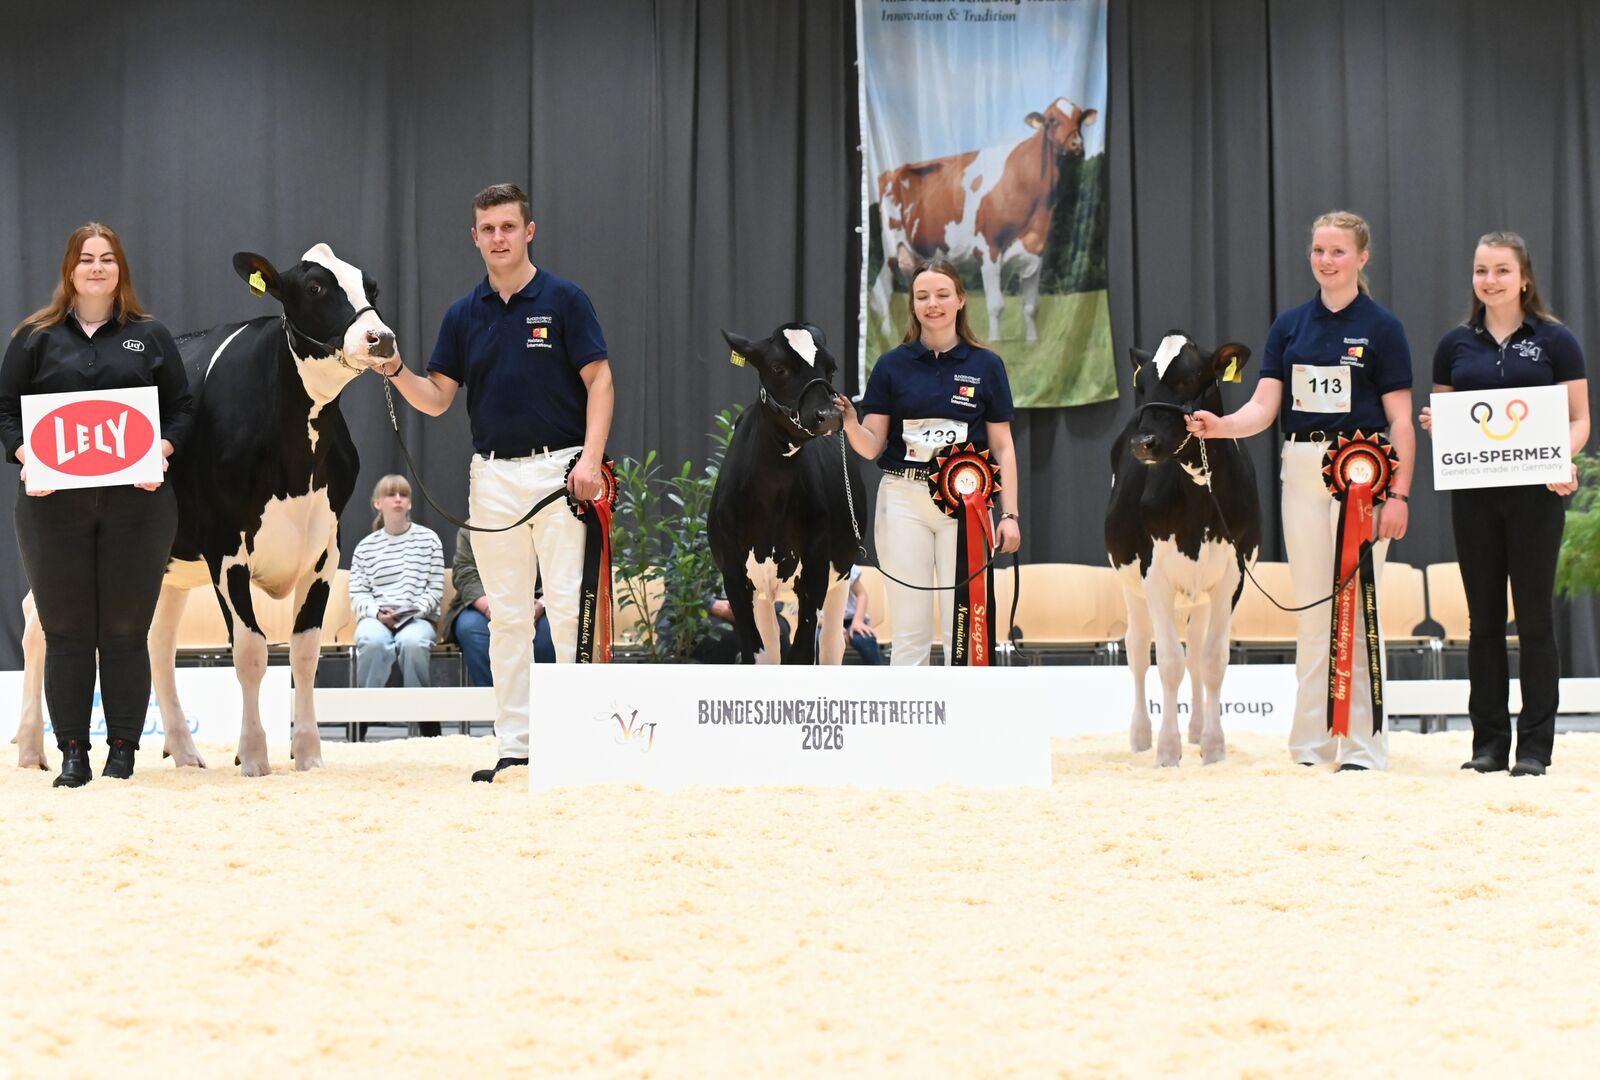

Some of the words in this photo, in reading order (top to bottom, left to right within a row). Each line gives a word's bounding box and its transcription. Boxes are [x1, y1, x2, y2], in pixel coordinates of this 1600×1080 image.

[881, 9, 943, 21] Innovation
[947, 8, 959, 21] &
[963, 8, 1016, 21] Tradition
[1308, 377, 1342, 394] 113
[53, 409, 129, 466] LELY
[922, 429, 957, 445] 139
[1441, 446, 1562, 466] GGI-SPERMEX
[1441, 467, 1481, 477] Genetics
[1483, 464, 1507, 474] made
[1511, 463, 1520, 473] in
[1521, 461, 1563, 473] Germany
[582, 590, 595, 644] Neumünster
[972, 603, 985, 662] Sieger
[1335, 668, 1351, 700] Jung
[697, 697, 947, 725] BUNDESJUNGZÜCHTERTREFFEN
[801, 725, 844, 750] 2026
